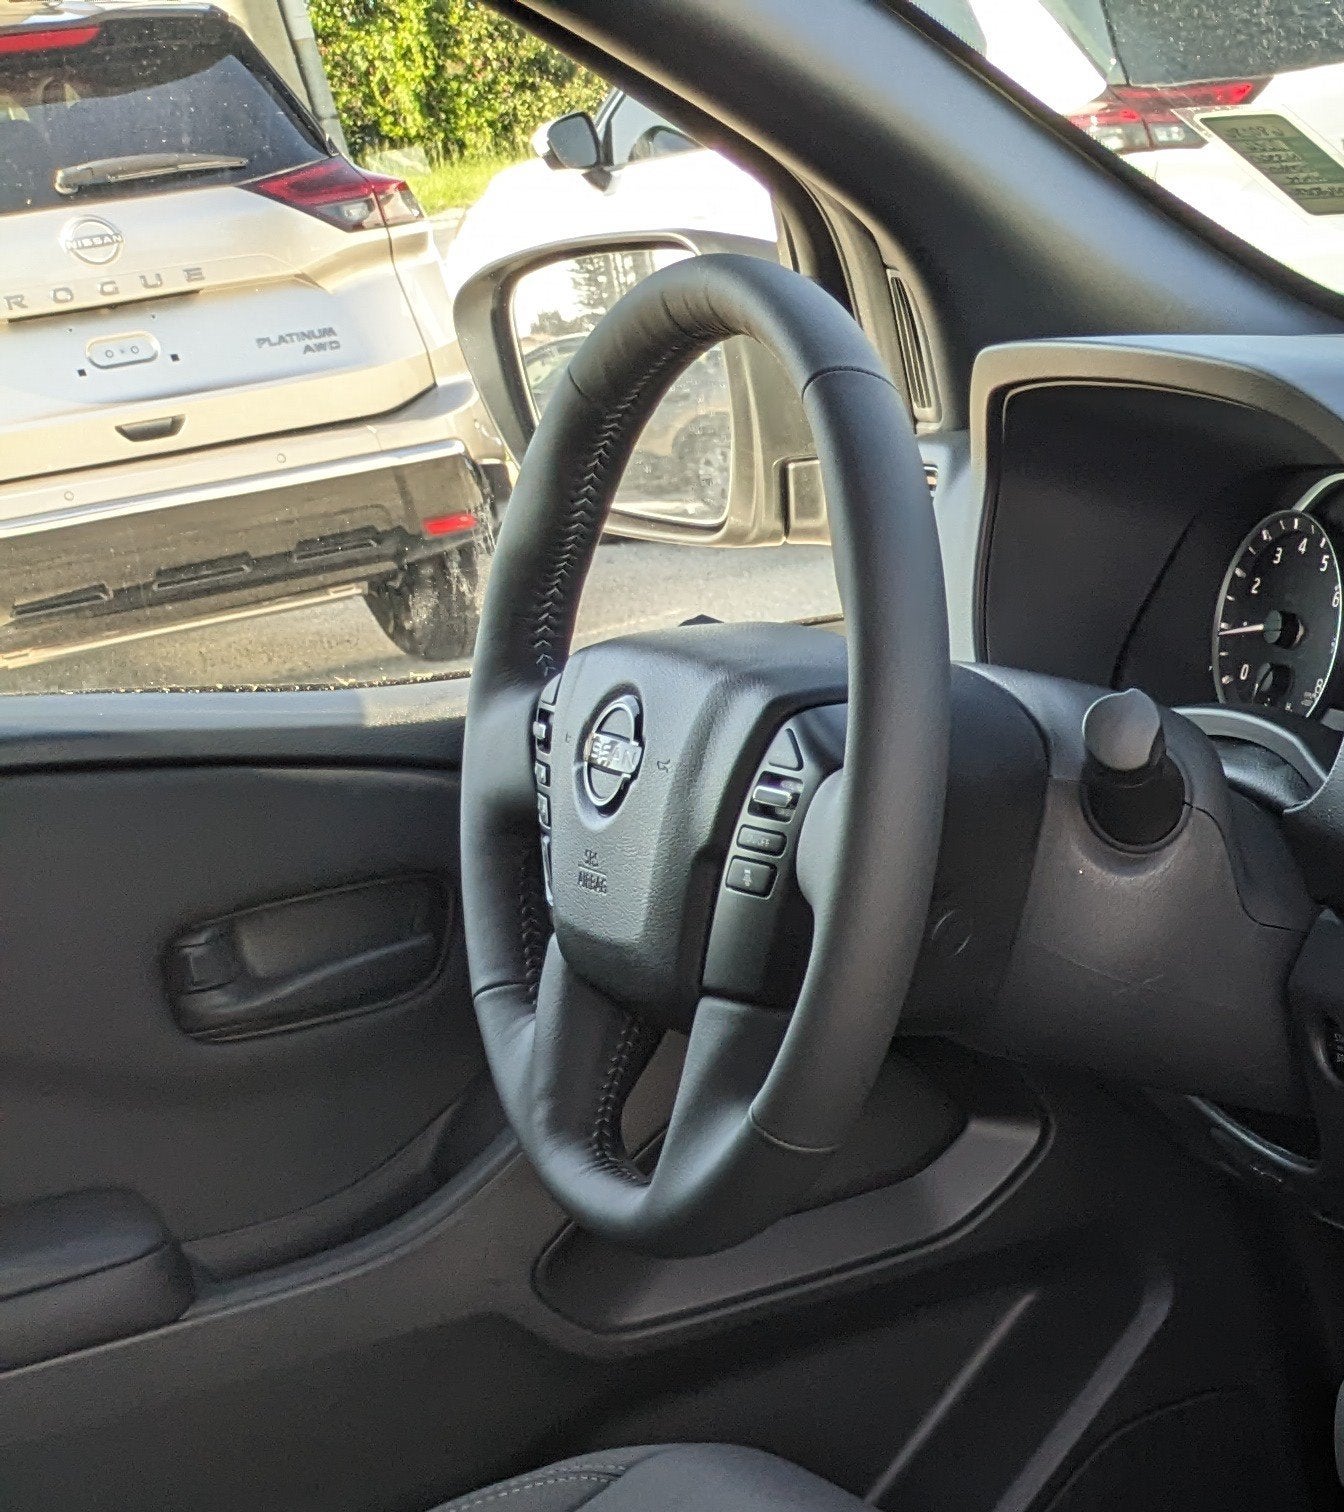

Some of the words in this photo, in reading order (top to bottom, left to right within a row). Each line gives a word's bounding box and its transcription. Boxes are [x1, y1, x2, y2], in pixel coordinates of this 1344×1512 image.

[65, 233, 124, 251] NISSAN
[3, 267, 206, 311] ROGUE
[255, 326, 338, 348] PLATINUM
[302, 340, 341, 355] AWD
